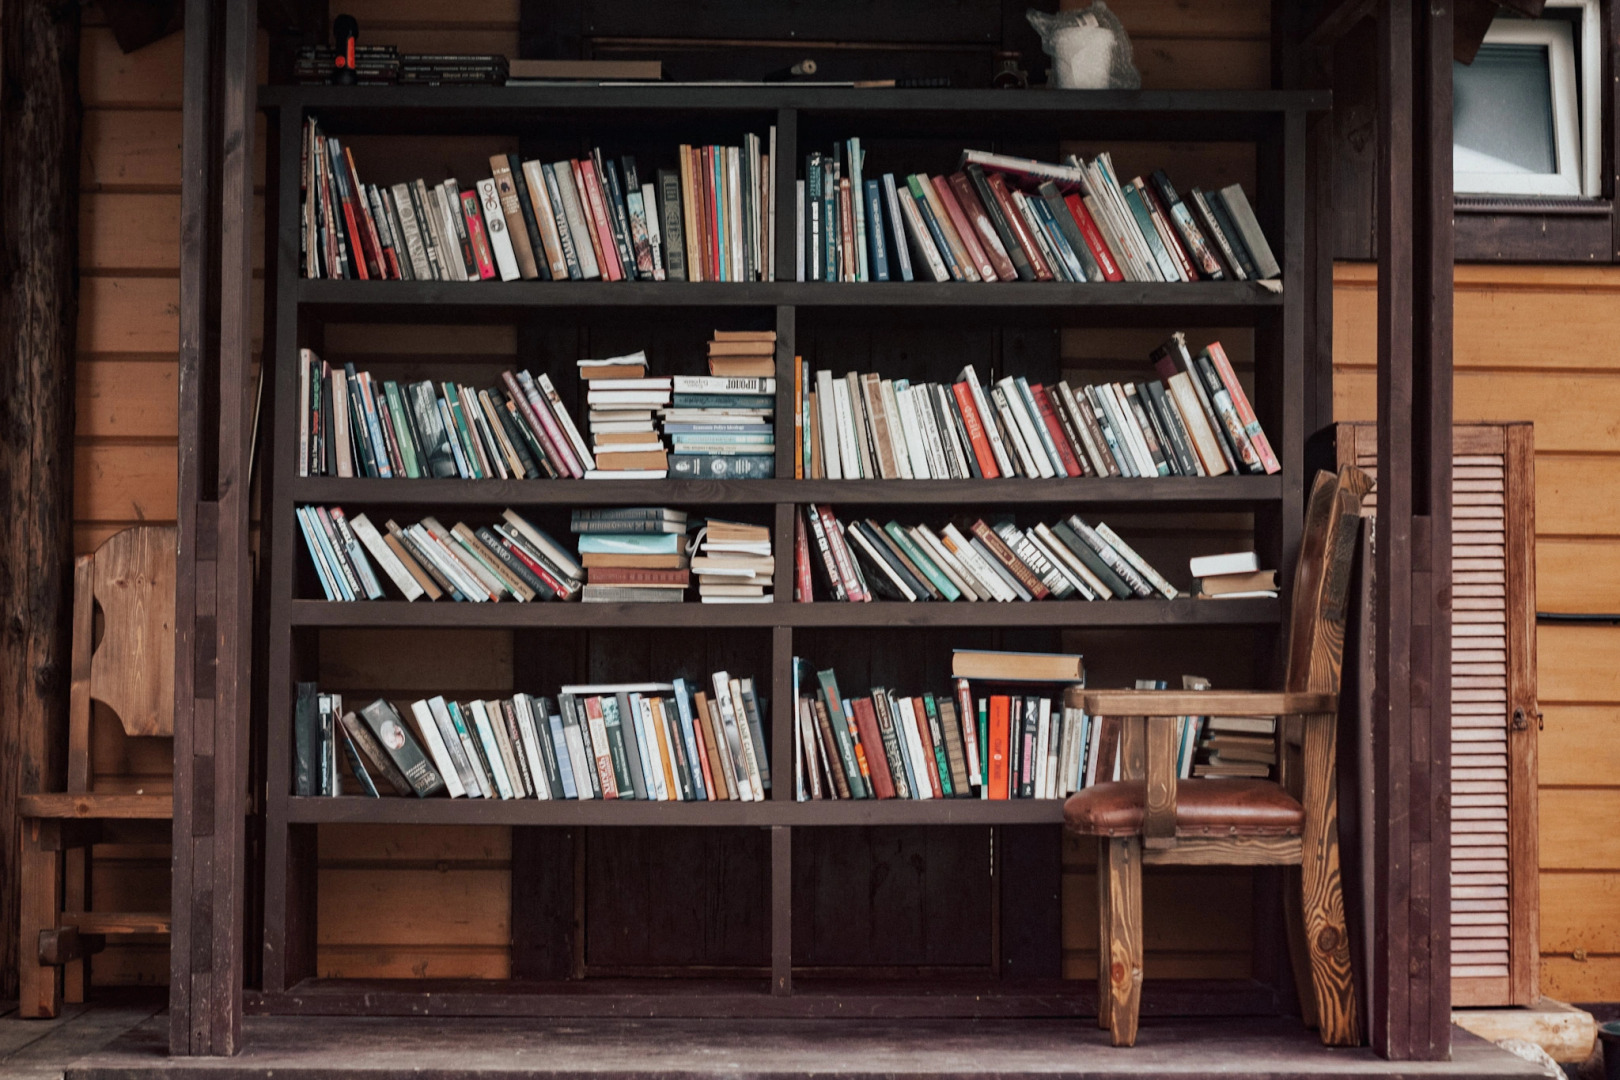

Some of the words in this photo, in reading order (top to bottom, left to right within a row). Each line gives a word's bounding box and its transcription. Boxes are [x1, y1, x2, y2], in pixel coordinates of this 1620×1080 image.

[555, 212, 576, 265] РАМАЯНА
[726, 378, 757, 390] ПРОЛОГ
[964, 406, 981, 440] ФРЕЙД
[596, 757, 612, 794] ЧУЖИХ
